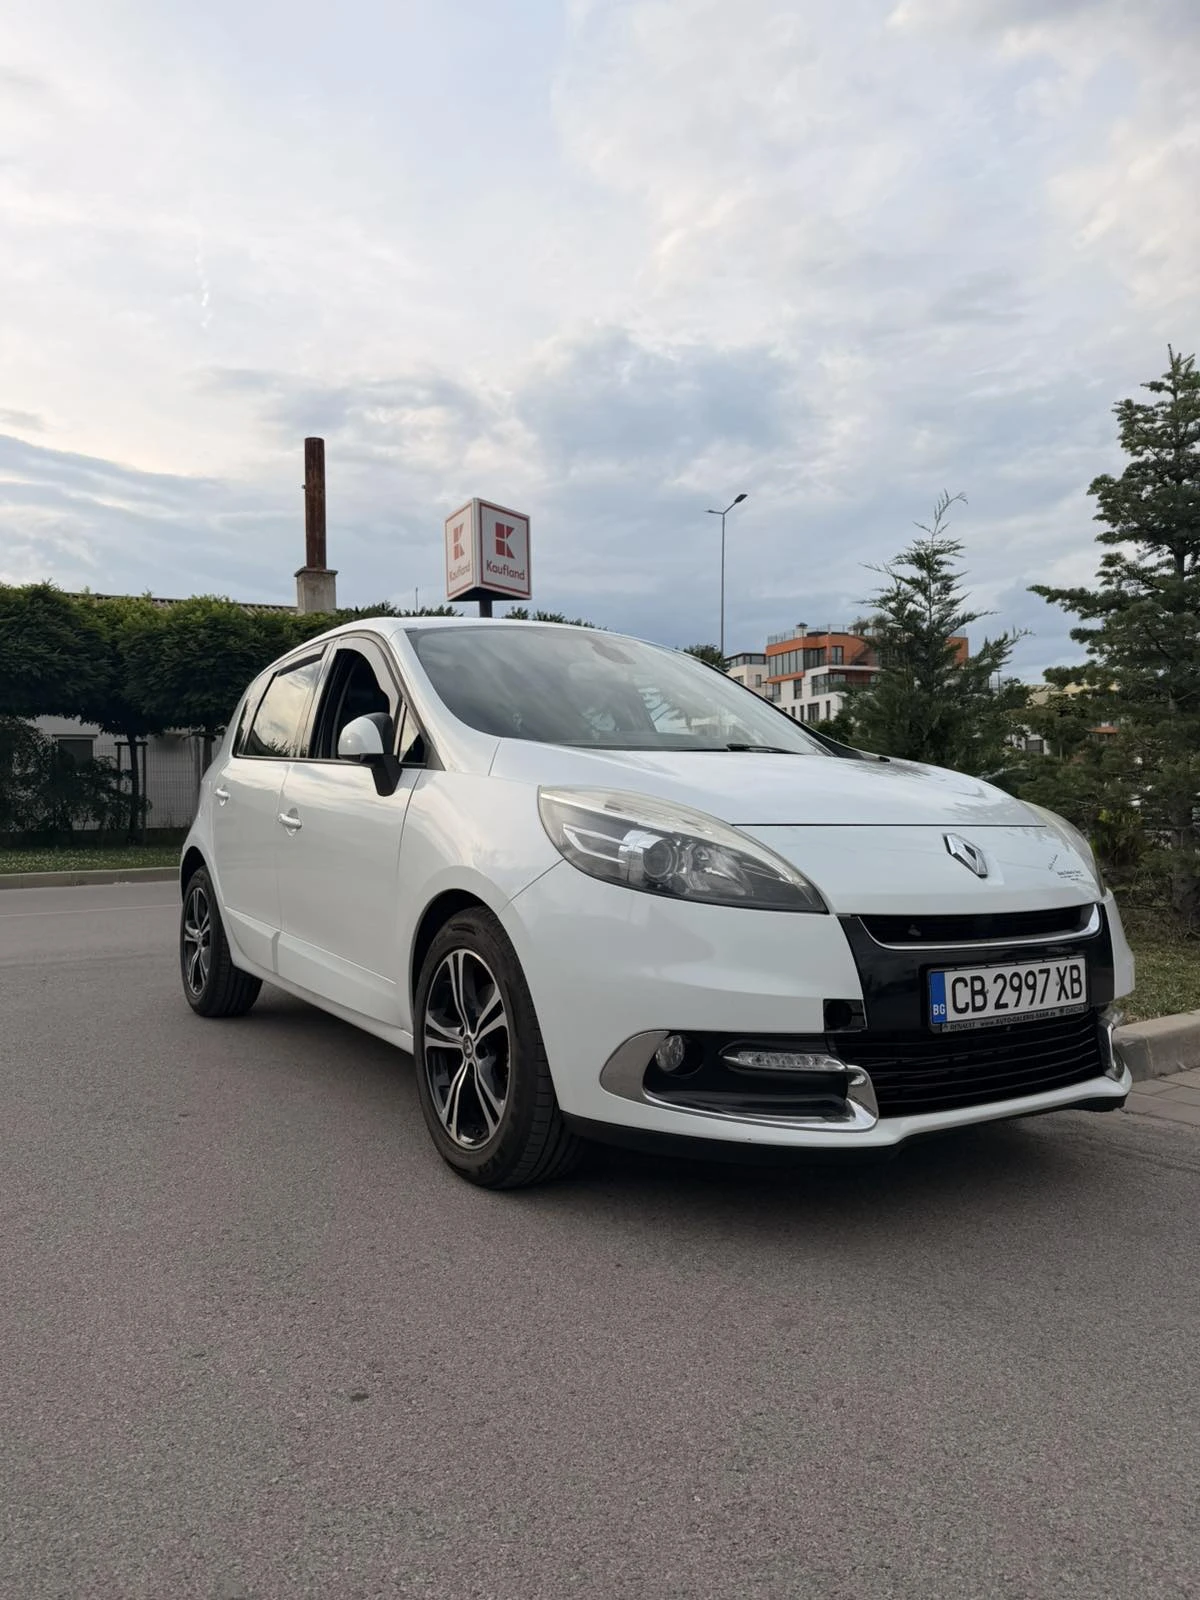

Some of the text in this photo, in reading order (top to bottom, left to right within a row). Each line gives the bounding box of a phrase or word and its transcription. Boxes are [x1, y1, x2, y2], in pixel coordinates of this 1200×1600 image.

[486, 560, 525, 580] Kaufland
[951, 964, 1083, 1014] CB 2997 XB
[932, 1004, 946, 1016] BG
